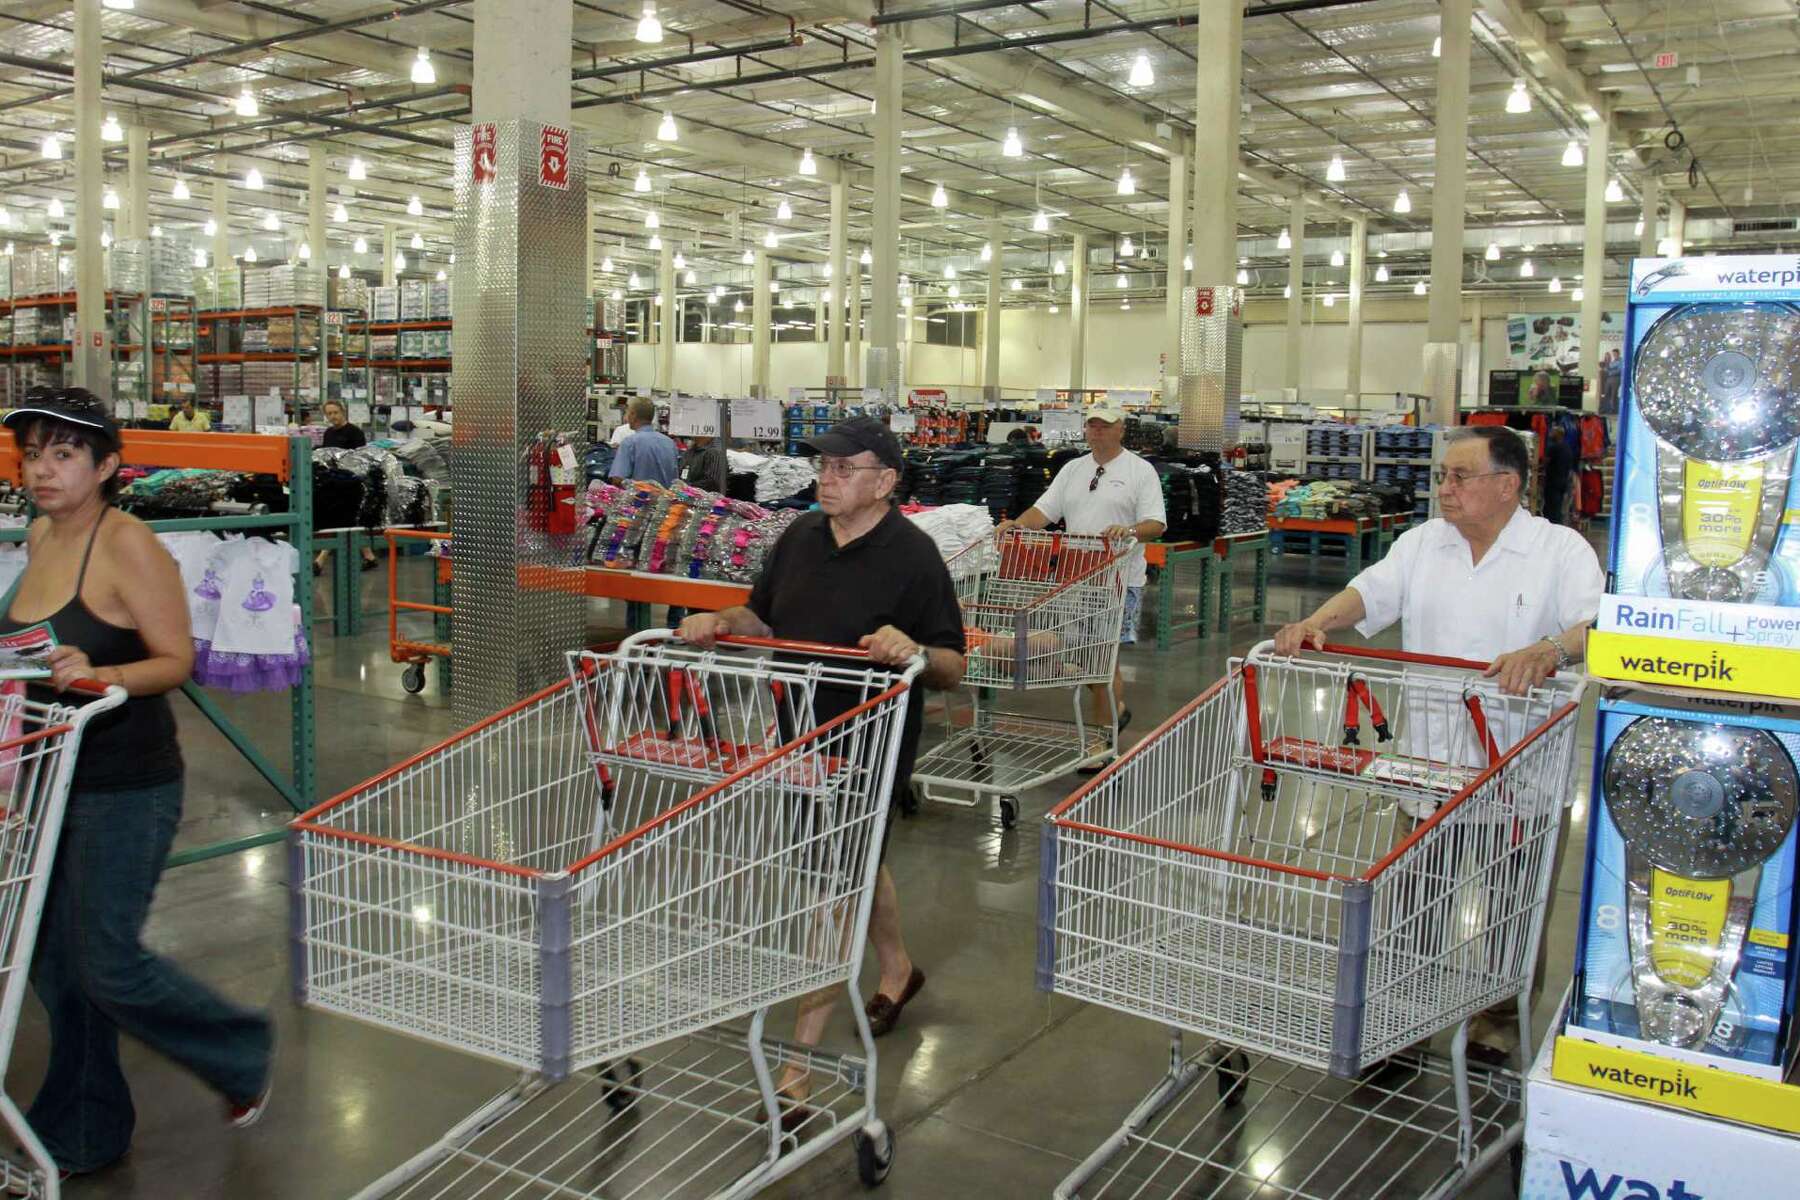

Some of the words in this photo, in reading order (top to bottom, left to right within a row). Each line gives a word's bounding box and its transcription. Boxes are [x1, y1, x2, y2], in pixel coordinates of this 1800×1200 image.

[1657, 55, 1676, 66] EXIT
[547, 135, 563, 145] FIRE
[690, 423, 714, 434] 11.99
[753, 427, 779, 438] 12.99
[1700, 513, 1742, 524] 30%
[1698, 524, 1742, 533] more
[1747, 615, 1800, 631] Power
[1746, 628, 1794, 646] Spray
[1620, 650, 1734, 683] waterpik
[1596, 904, 1619, 929] 8
[1667, 921, 1708, 936] 30%
[1665, 932, 1708, 945] more
[1714, 1020, 1734, 1039] 8
[1588, 1063, 1698, 1100] waterpik
